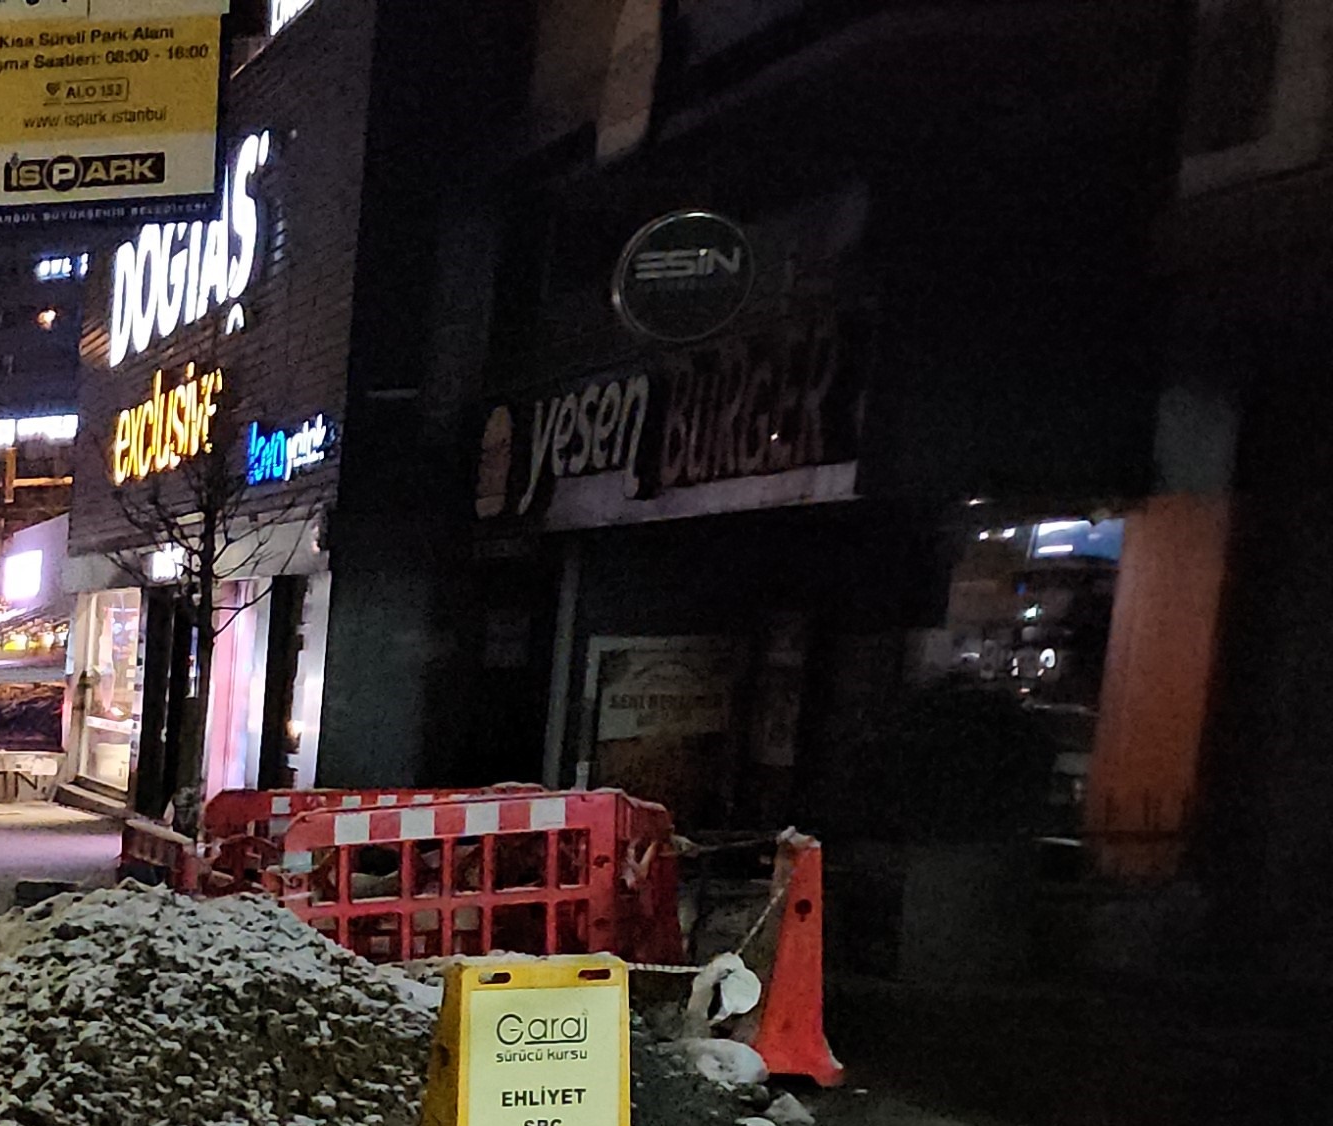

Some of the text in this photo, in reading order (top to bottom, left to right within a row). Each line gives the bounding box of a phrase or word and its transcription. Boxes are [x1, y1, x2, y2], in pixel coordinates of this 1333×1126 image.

[90, 27, 128, 43] Park
[134, 26, 174, 40] Alanı
[65, 84, 97, 99] ALO
[516, 328, 837, 517] yesen BURGER
[496, 1010, 588, 1046] Garaj
[495, 1047, 588, 1063] sürücü kursu
[501, 1086, 587, 1108] EHLİYET
